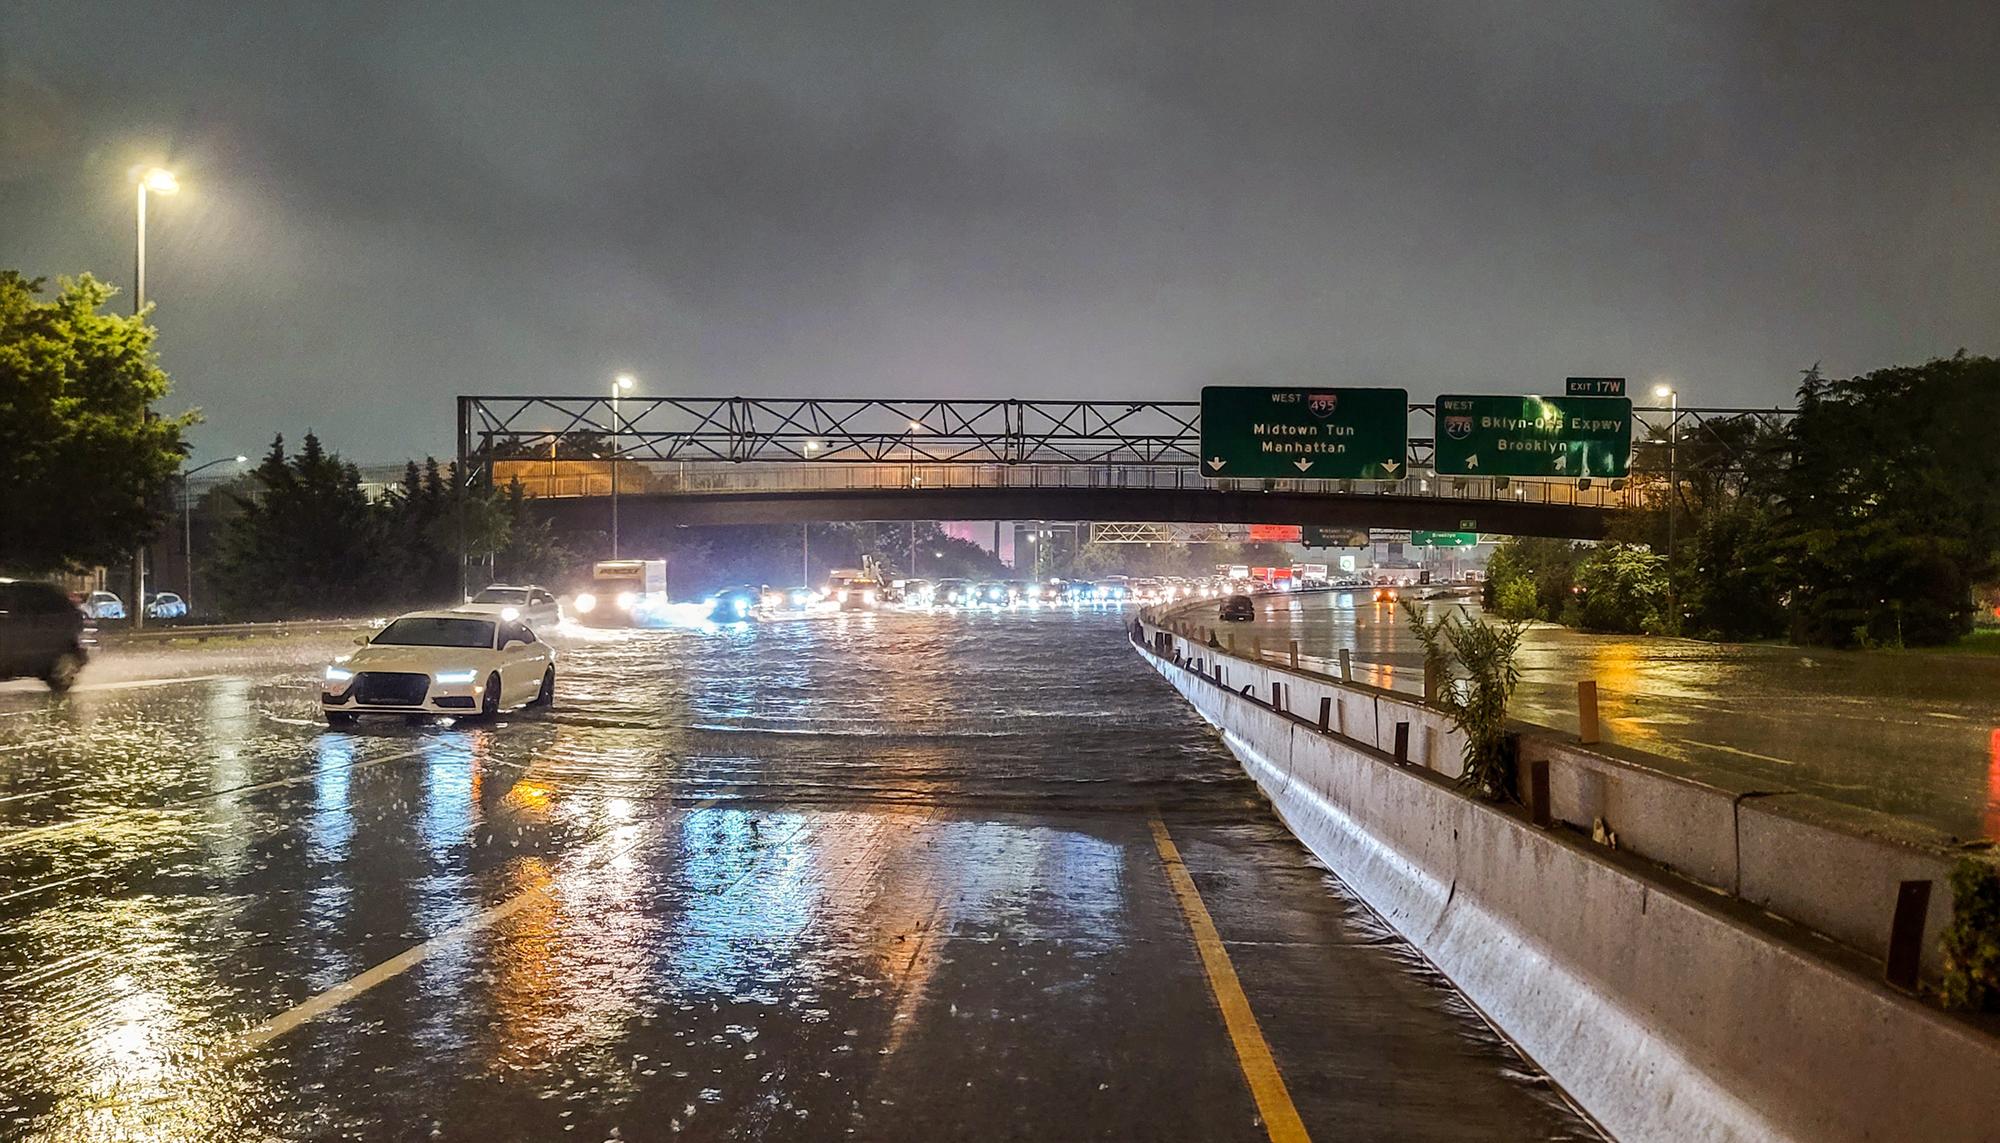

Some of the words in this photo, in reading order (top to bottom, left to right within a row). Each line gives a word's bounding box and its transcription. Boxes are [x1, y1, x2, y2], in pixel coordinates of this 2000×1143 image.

[1571, 383, 1591, 391] EXIT
[1597, 382, 1621, 392] 17W
[1272, 393, 1301, 403] WEST
[1311, 400, 1335, 411] 495
[1444, 401, 1474, 410] WEST
[1254, 423, 1318, 436] Midtown
[1327, 424, 1354, 436] Tun
[1449, 424, 1472, 433] 278
[1571, 417, 1622, 432] Expwy
[1262, 441, 1346, 453] Manhattan
[1498, 439, 1567, 454] Brooklyn
